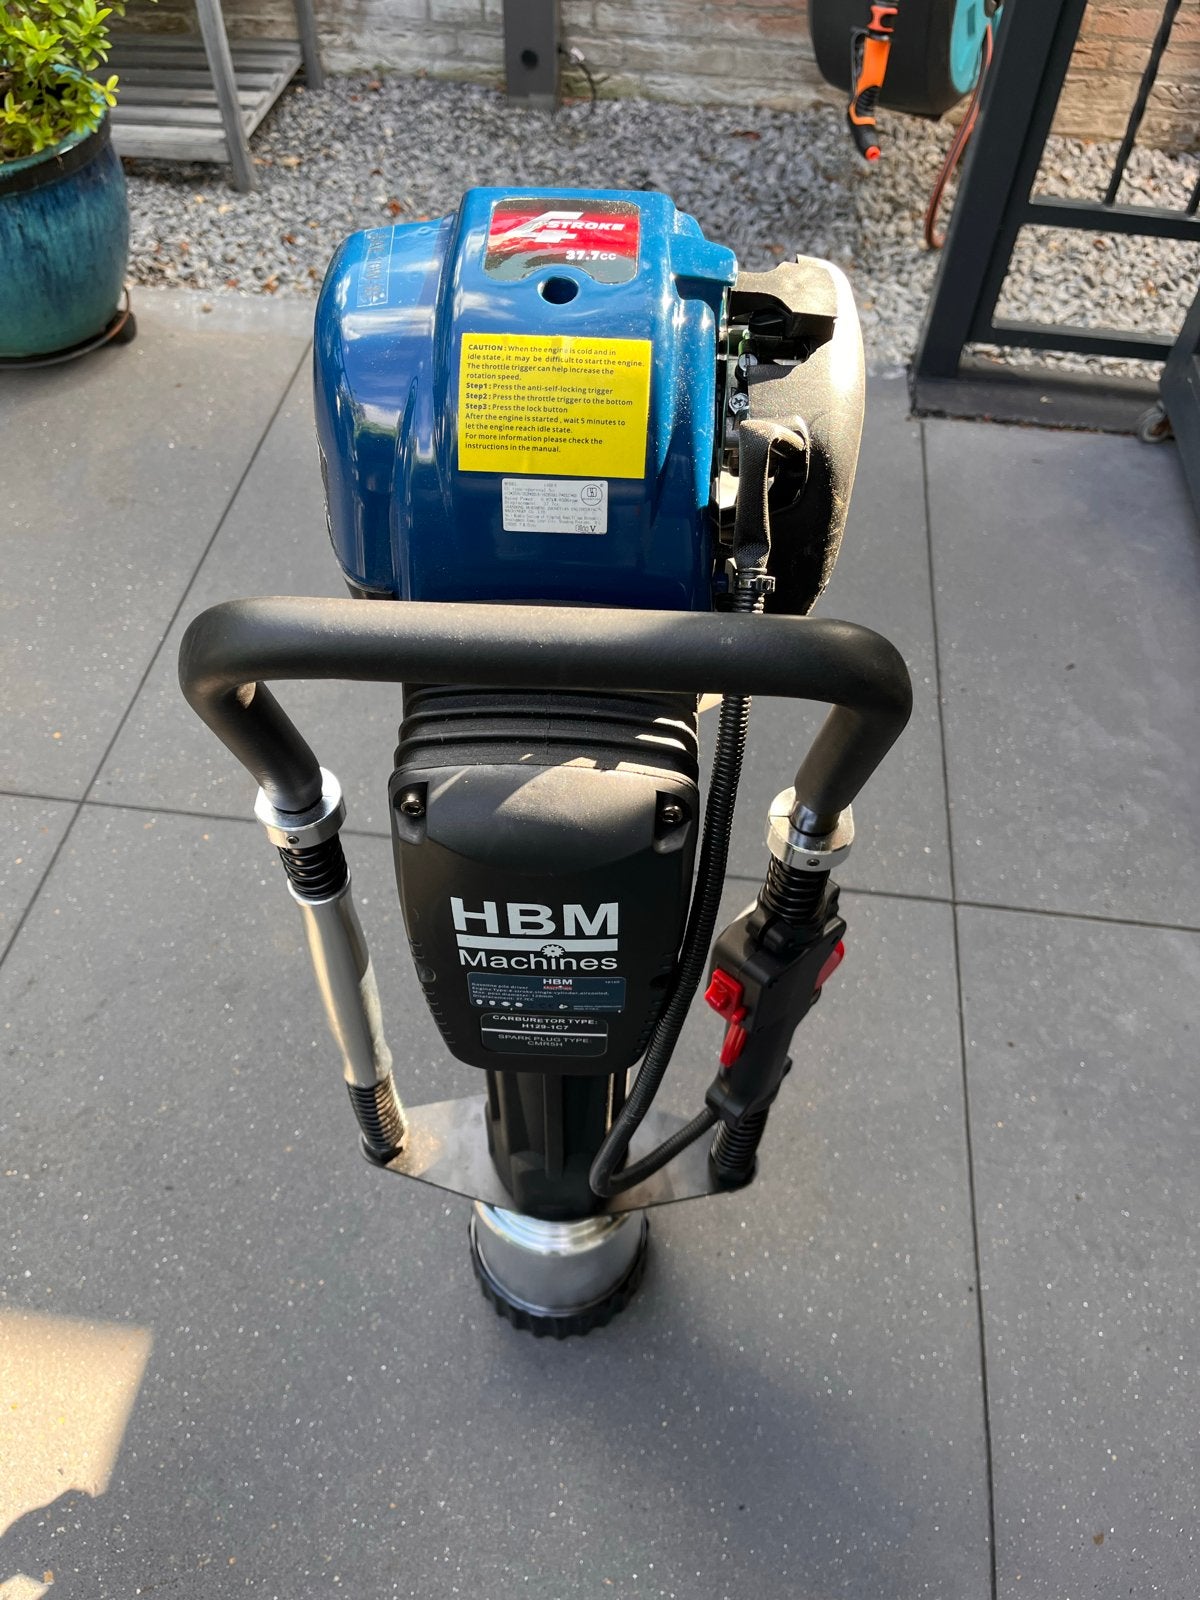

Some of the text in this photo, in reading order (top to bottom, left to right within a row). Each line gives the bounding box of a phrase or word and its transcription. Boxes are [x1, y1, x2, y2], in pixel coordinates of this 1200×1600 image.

[546, 220, 625, 231] STROKE
[565, 250, 617, 261] 37.7cc
[543, 347, 568, 355] engine
[545, 356, 574, 364] difficult
[617, 360, 645, 368] engine.
[481, 363, 510, 371] throttle
[511, 364, 536, 372] trigger
[551, 366, 568, 374] help
[527, 385, 587, 394] anti-self-locking
[587, 387, 613, 395] trigger
[527, 394, 555, 402] throttle
[556, 396, 582, 404] trigger
[605, 398, 633, 406] bottom
[498, 414, 523, 422] engine
[586, 418, 616, 426] minutes
[489, 424, 514, 432] engine
[498, 433, 542, 442] information
[531, 445, 561, 453] manual.
[450, 896, 619, 936] HBM
[458, 948, 618, 971] Machines
[492, 1015, 566, 1024] CARBURETOR
